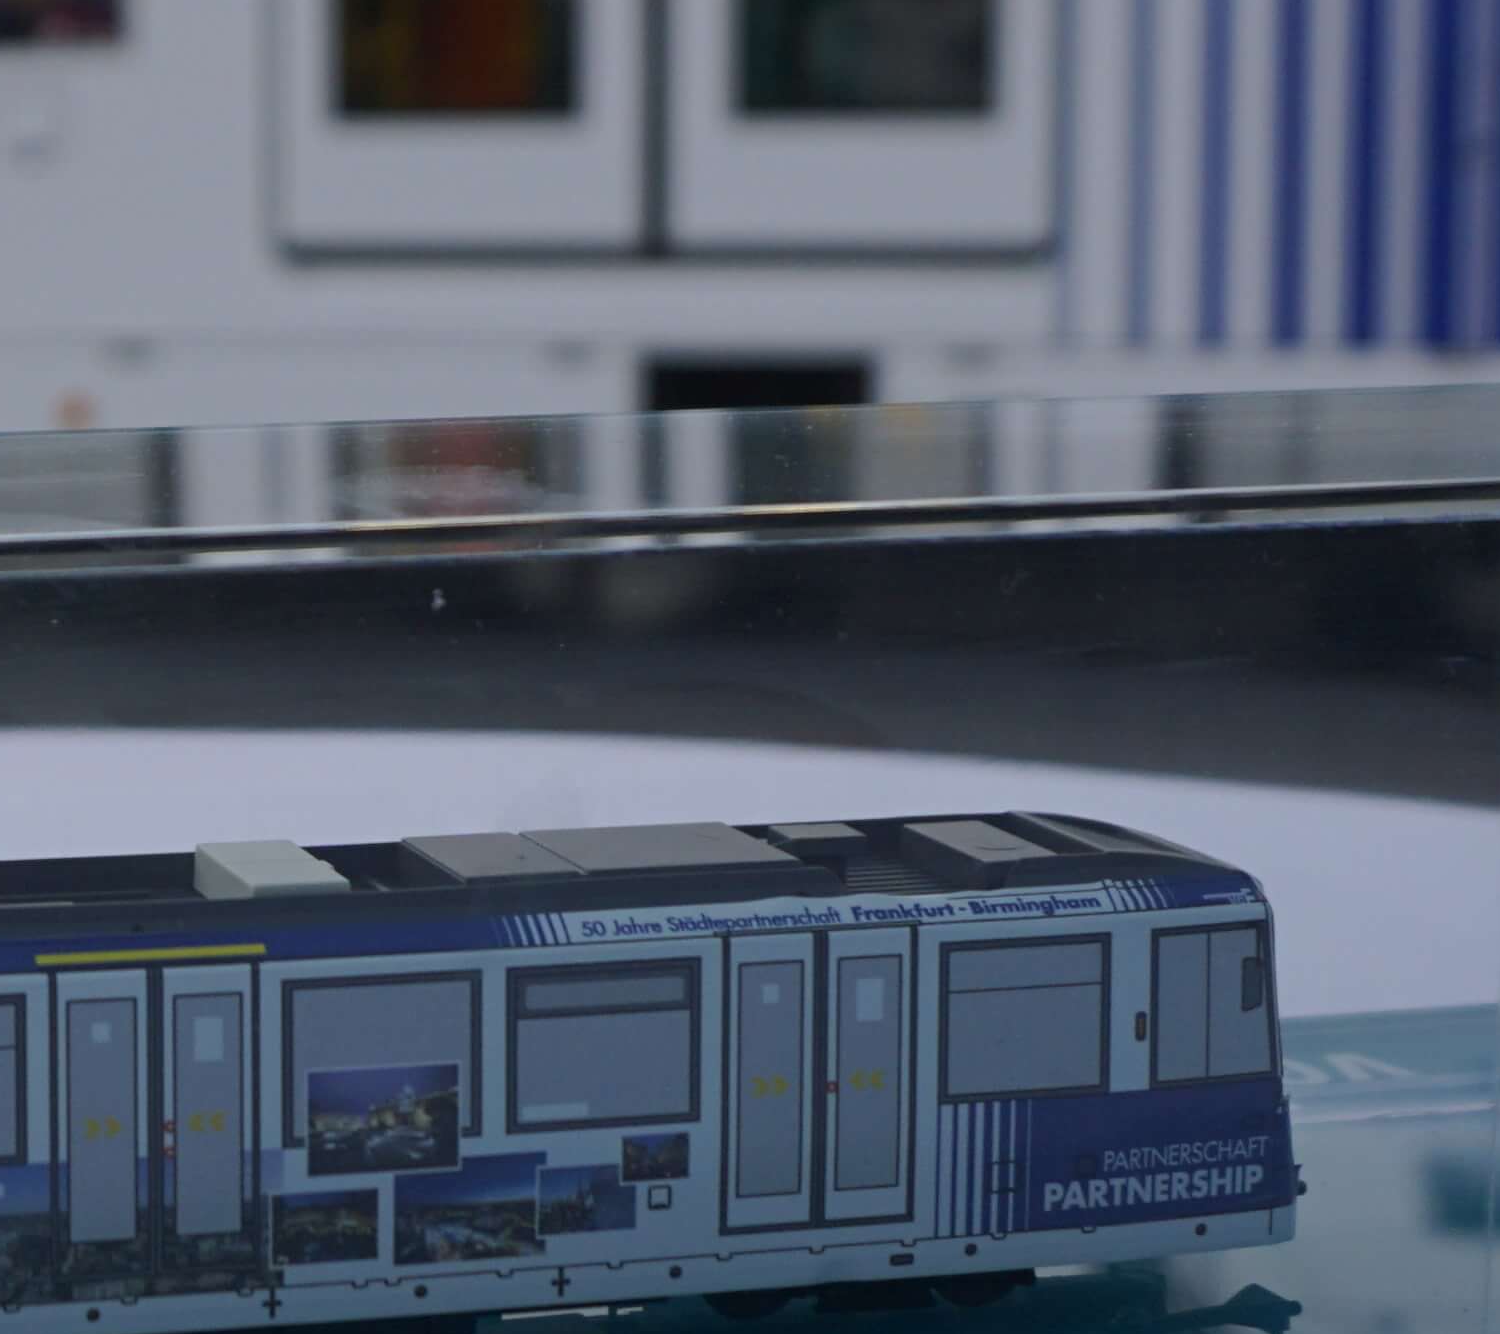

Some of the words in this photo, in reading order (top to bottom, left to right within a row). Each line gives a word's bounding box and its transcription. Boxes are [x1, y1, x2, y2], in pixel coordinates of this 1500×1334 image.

[582, 920, 607, 937] 50
[612, 916, 663, 936] Jahre
[666, 906, 841, 933] Städtepartnerschaft
[852, 902, 955, 922] Frankfurt
[968, 895, 1102, 916] Birmingham
[1102, 1135, 1269, 1172] PARTNERSCHAFT
[1043, 1164, 1264, 1212] PARTNERSHIP
